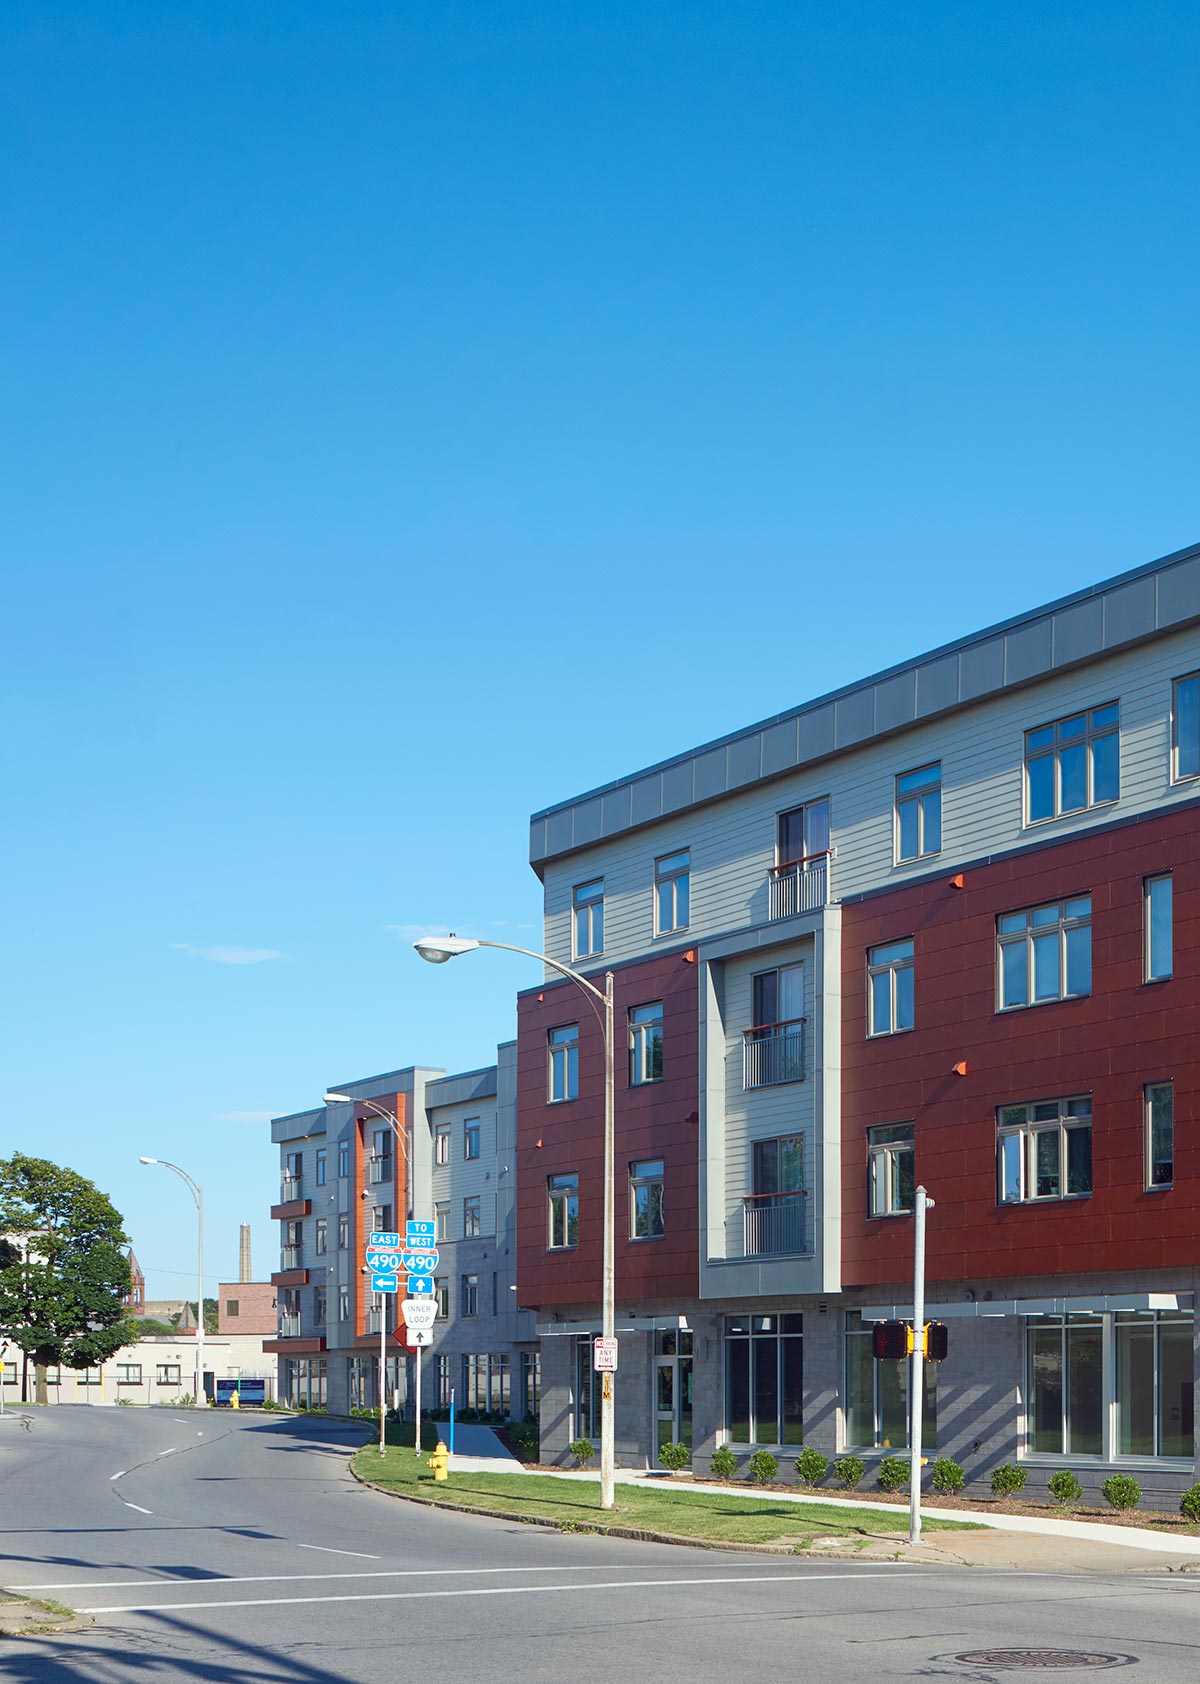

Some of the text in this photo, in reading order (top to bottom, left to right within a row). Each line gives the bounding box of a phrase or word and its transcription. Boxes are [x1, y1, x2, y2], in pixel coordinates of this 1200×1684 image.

[414, 1223, 427, 1232] TO
[372, 1235, 397, 1245] EAST
[410, 1237, 431, 1246] WEST
[370, 1254, 399, 1268] 490
[406, 1256, 435, 1270] 490
[408, 1305, 432, 1313] INNER
[409, 1315, 431, 1323] LOOP
